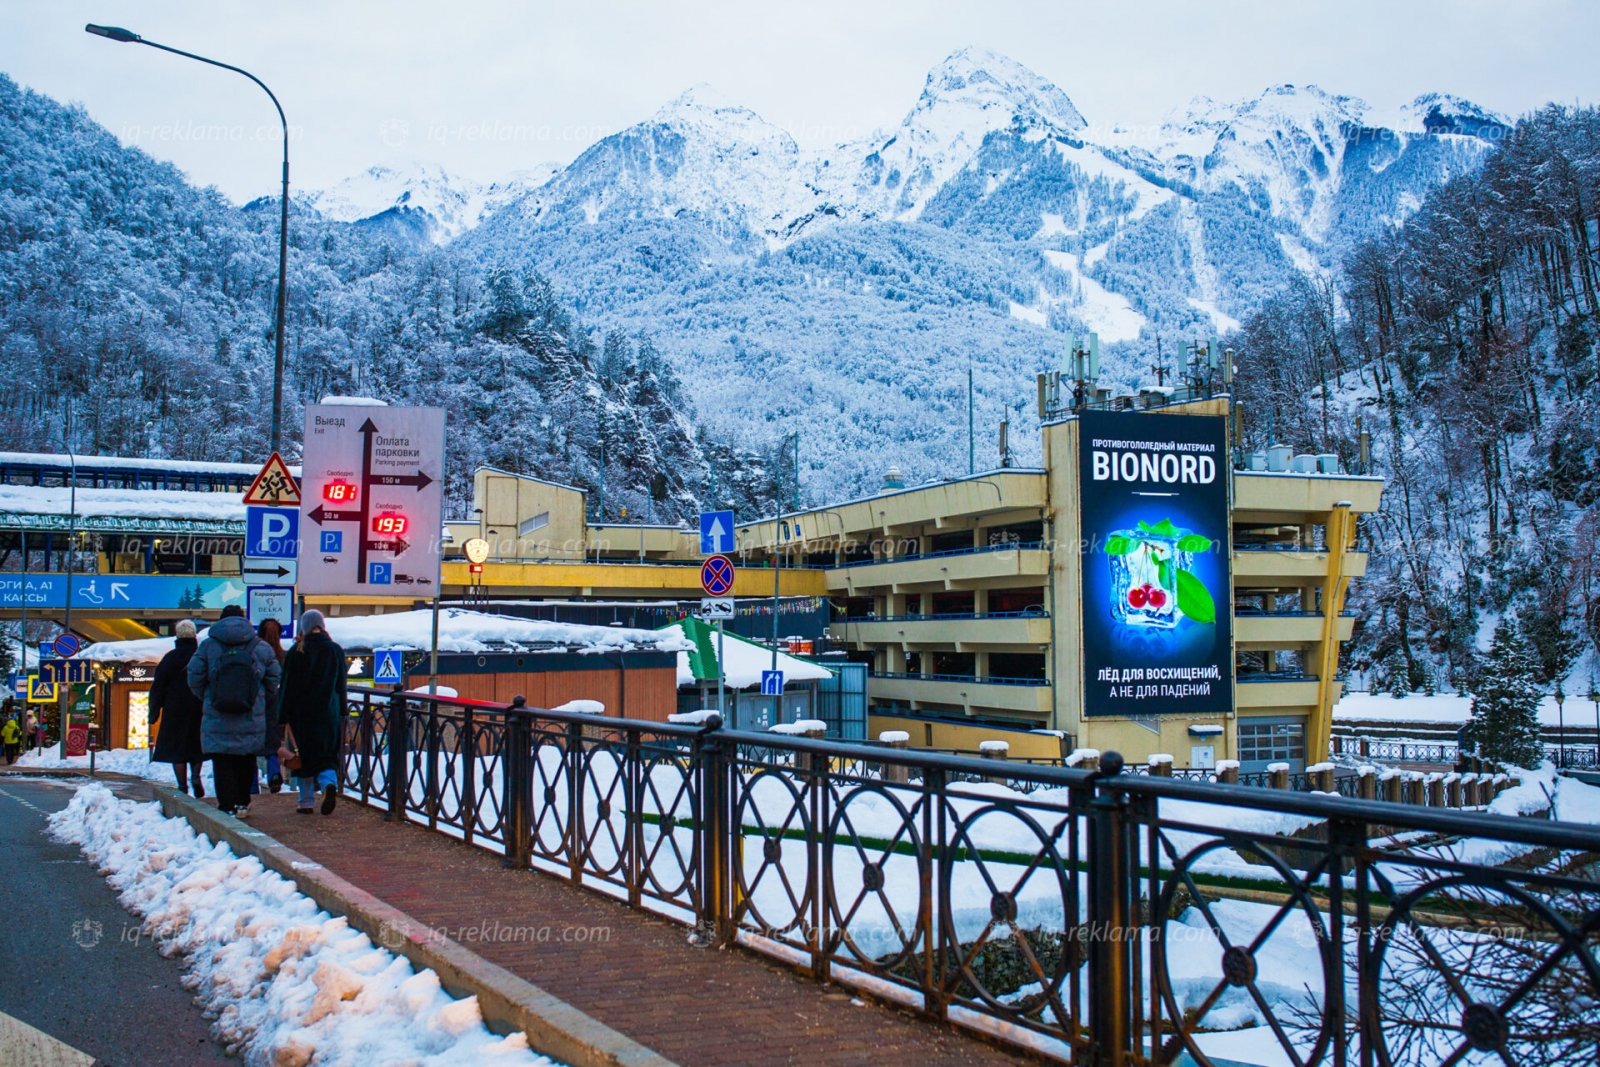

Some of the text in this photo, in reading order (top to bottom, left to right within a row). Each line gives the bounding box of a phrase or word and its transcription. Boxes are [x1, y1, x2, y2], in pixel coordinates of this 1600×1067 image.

[315, 415, 346, 427] Выезд
[376, 435, 410, 447] Оплата
[1092, 438, 1215, 452] ПРОТИВОГОЛОЛЕДНЫЙ МАТЕРИАЛ
[375, 448, 420, 458] парковки
[375, 459, 396, 467] Parking
[1092, 450, 1216, 484] BIONORD
[326, 469, 354, 477] Свободно
[381, 476, 394, 484] 150
[375, 502, 403, 510] Свободно
[323, 512, 332, 520] 50
[377, 517, 405, 533] 193
[261, 512, 291, 552] P
[373, 541, 382, 550] 10
[40, 581, 53, 590] А1
[3, 593, 47, 602] КАССЫ
[1097, 664, 1222, 683] ЛЁД ДЛЯ ВОСХИЩЕНИЙ,
[1109, 681, 1211, 699] А НЕ ДЛЯ ПАДЕНИЙ
